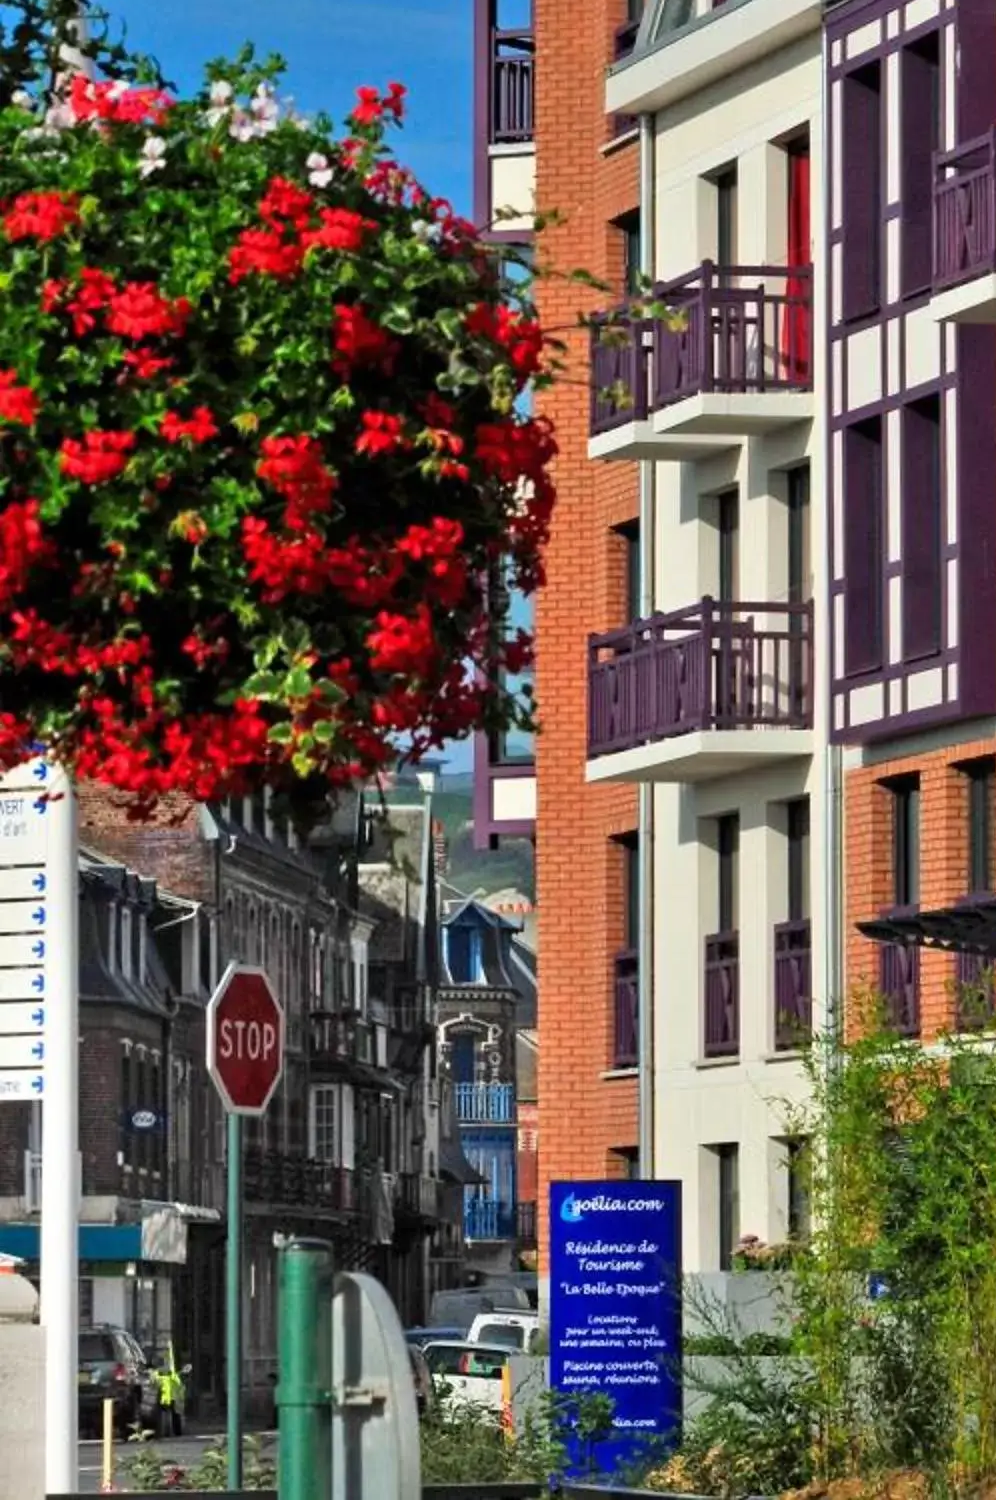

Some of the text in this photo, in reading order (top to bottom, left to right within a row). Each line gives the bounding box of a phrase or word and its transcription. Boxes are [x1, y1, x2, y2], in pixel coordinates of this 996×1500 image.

[220, 1018, 276, 1060] STOP
[565, 1239, 659, 1256] Résidence de
[577, 1257, 645, 1272] Tourisme
[582, 1281, 614, 1295] Belle
[587, 1313, 639, 1325] Locations
[565, 1326, 590, 1338] pour
[591, 1327, 606, 1336] un
[559, 1338, 578, 1348] une
[627, 1339, 641, 1348] ou
[563, 1360, 604, 1372] Piscine
